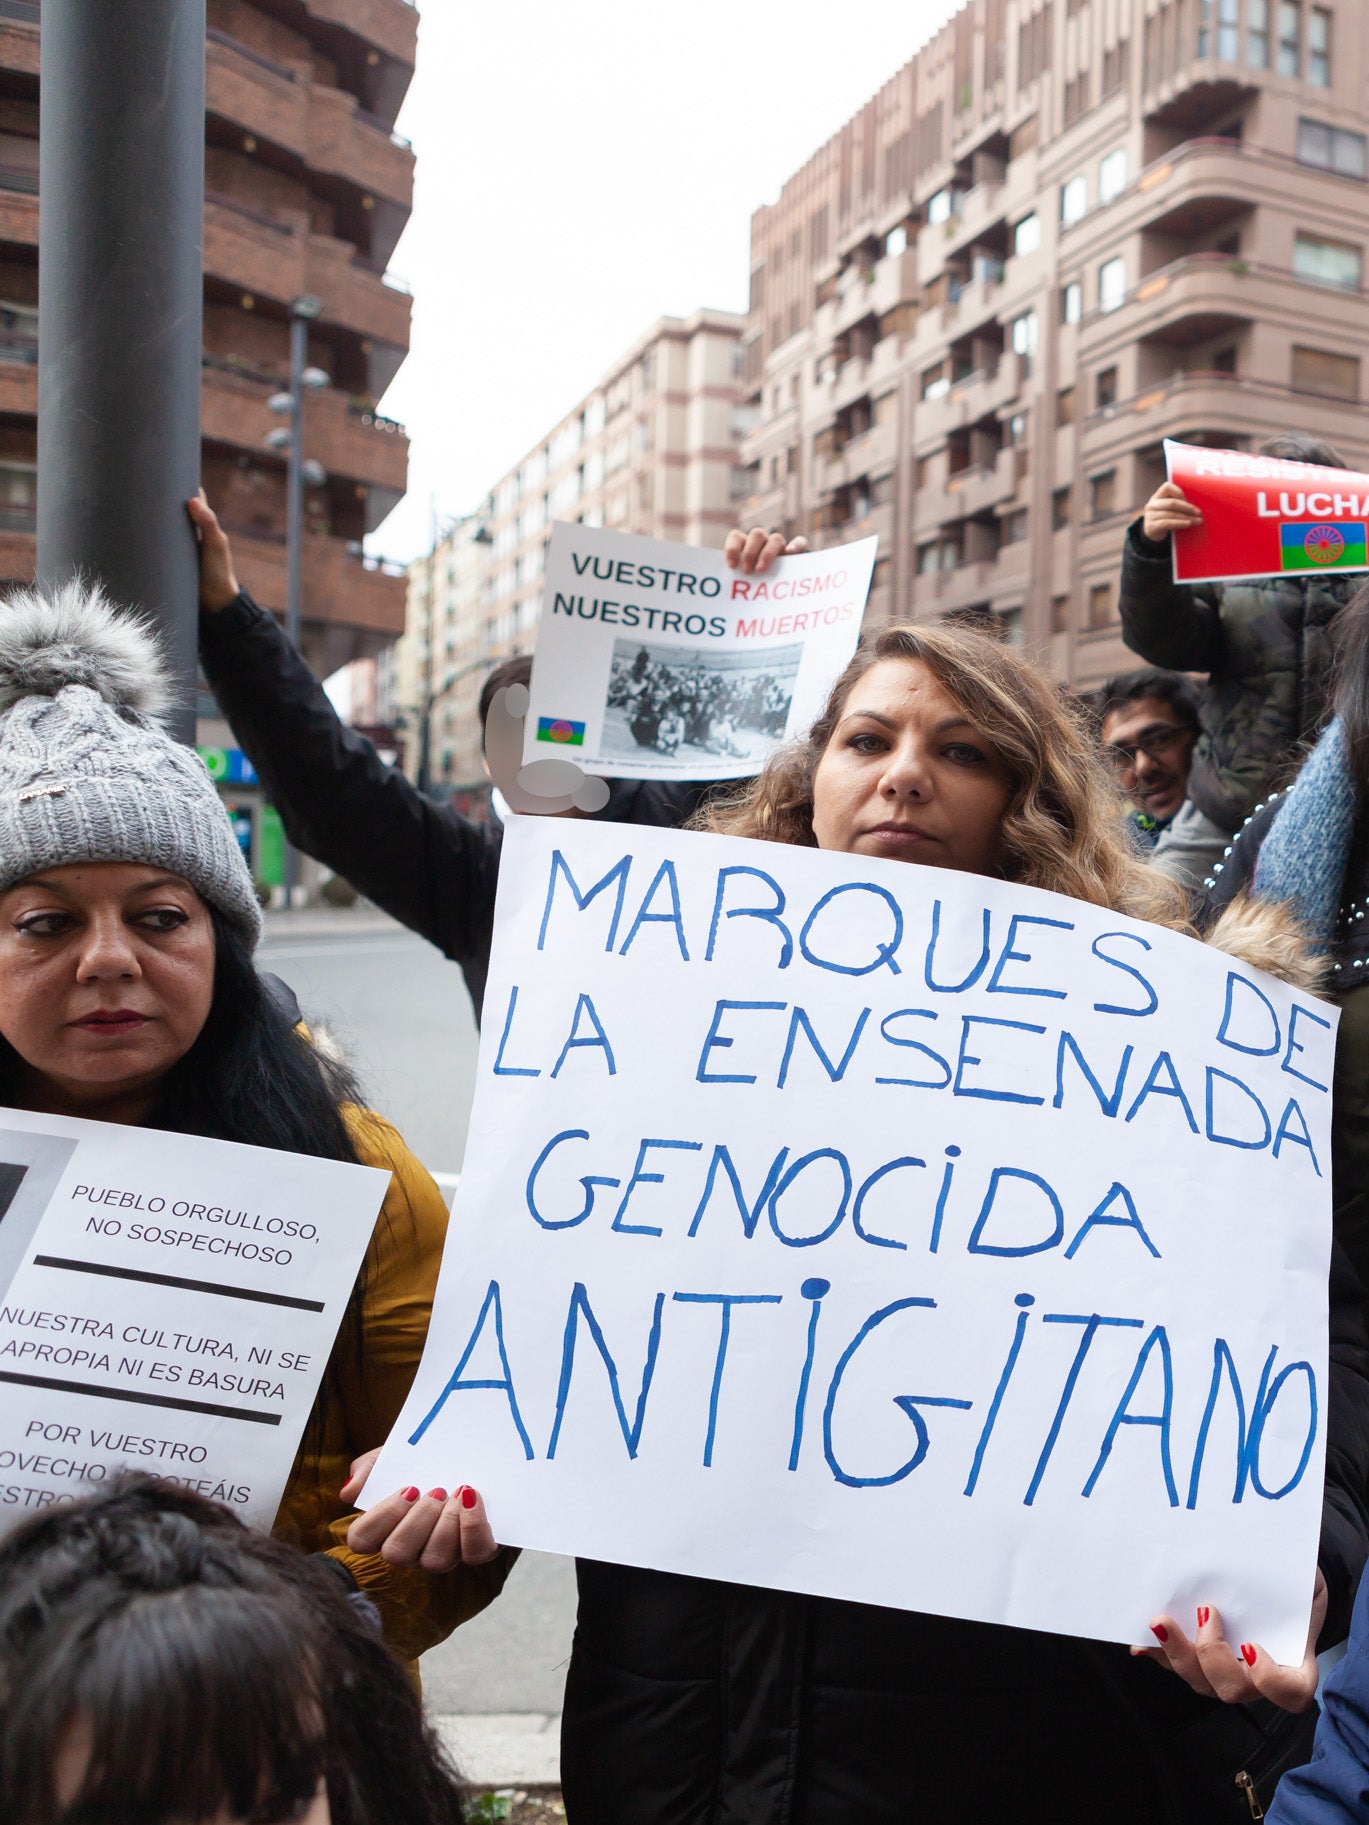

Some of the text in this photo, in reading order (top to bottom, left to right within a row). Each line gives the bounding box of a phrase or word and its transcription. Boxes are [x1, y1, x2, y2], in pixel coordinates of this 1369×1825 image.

[572, 552, 849, 601] VUESTRO RACISMO
[552, 592, 857, 639] NUESTROS MUERTOS
[537, 849, 1332, 1093] MARQUES DE
[492, 986, 1324, 1178] LA ENSENADA
[71, 1185, 321, 1244] PUEBLO ORGULLOSO,
[85, 1216, 293, 1266] NO SOSPECHOSO
[0, 1306, 312, 1372] NUESTRA CULTURA, NI SE
[0, 1340, 286, 1400] APROPIA NI ES BASURA
[25, 1421, 208, 1463] POR VUESTRO
